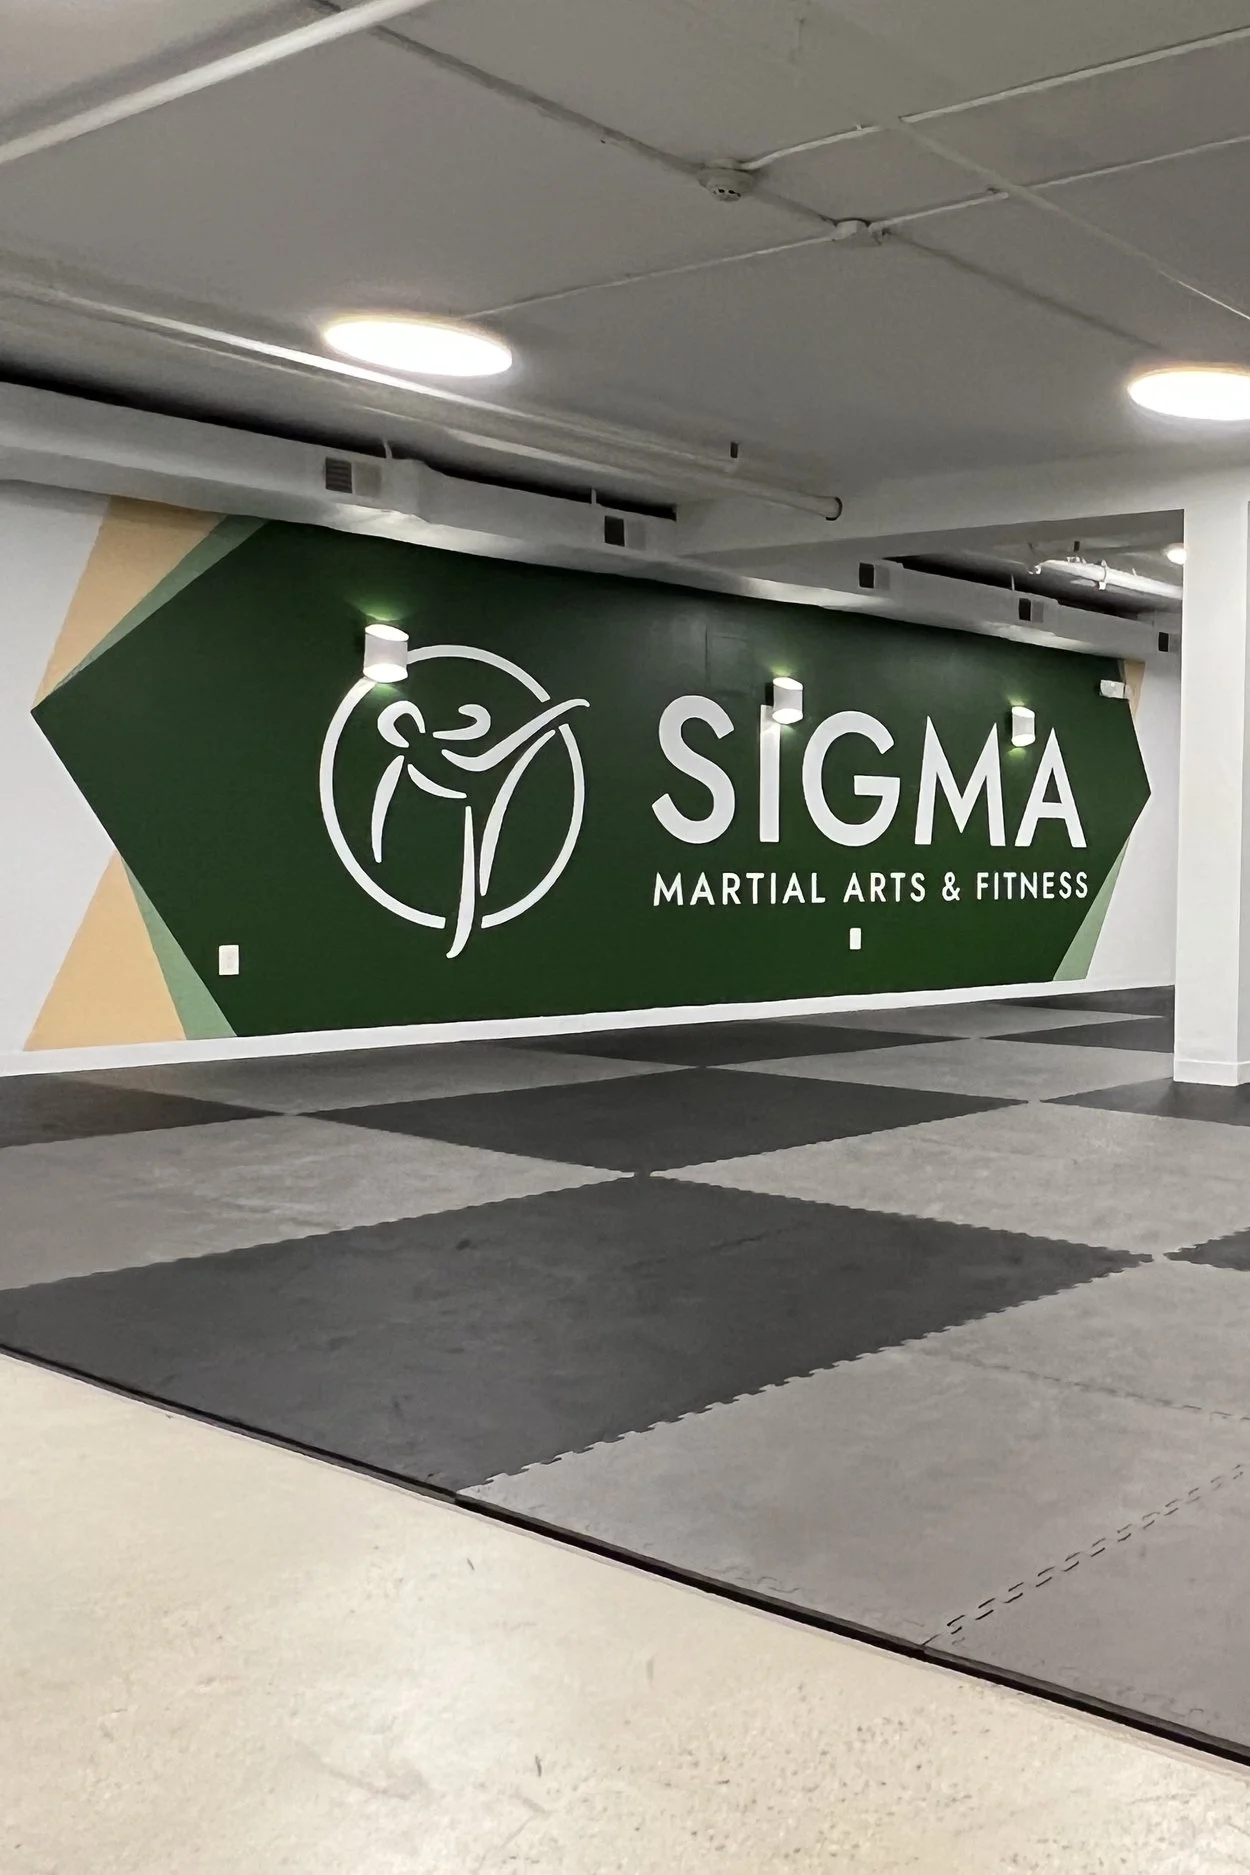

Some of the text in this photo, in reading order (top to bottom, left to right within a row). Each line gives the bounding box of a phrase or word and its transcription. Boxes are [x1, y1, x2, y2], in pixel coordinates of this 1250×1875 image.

[651, 694, 1087, 848] SIGMA
[653, 871, 1089, 907] MARTIAL ARTS & FITNESS
